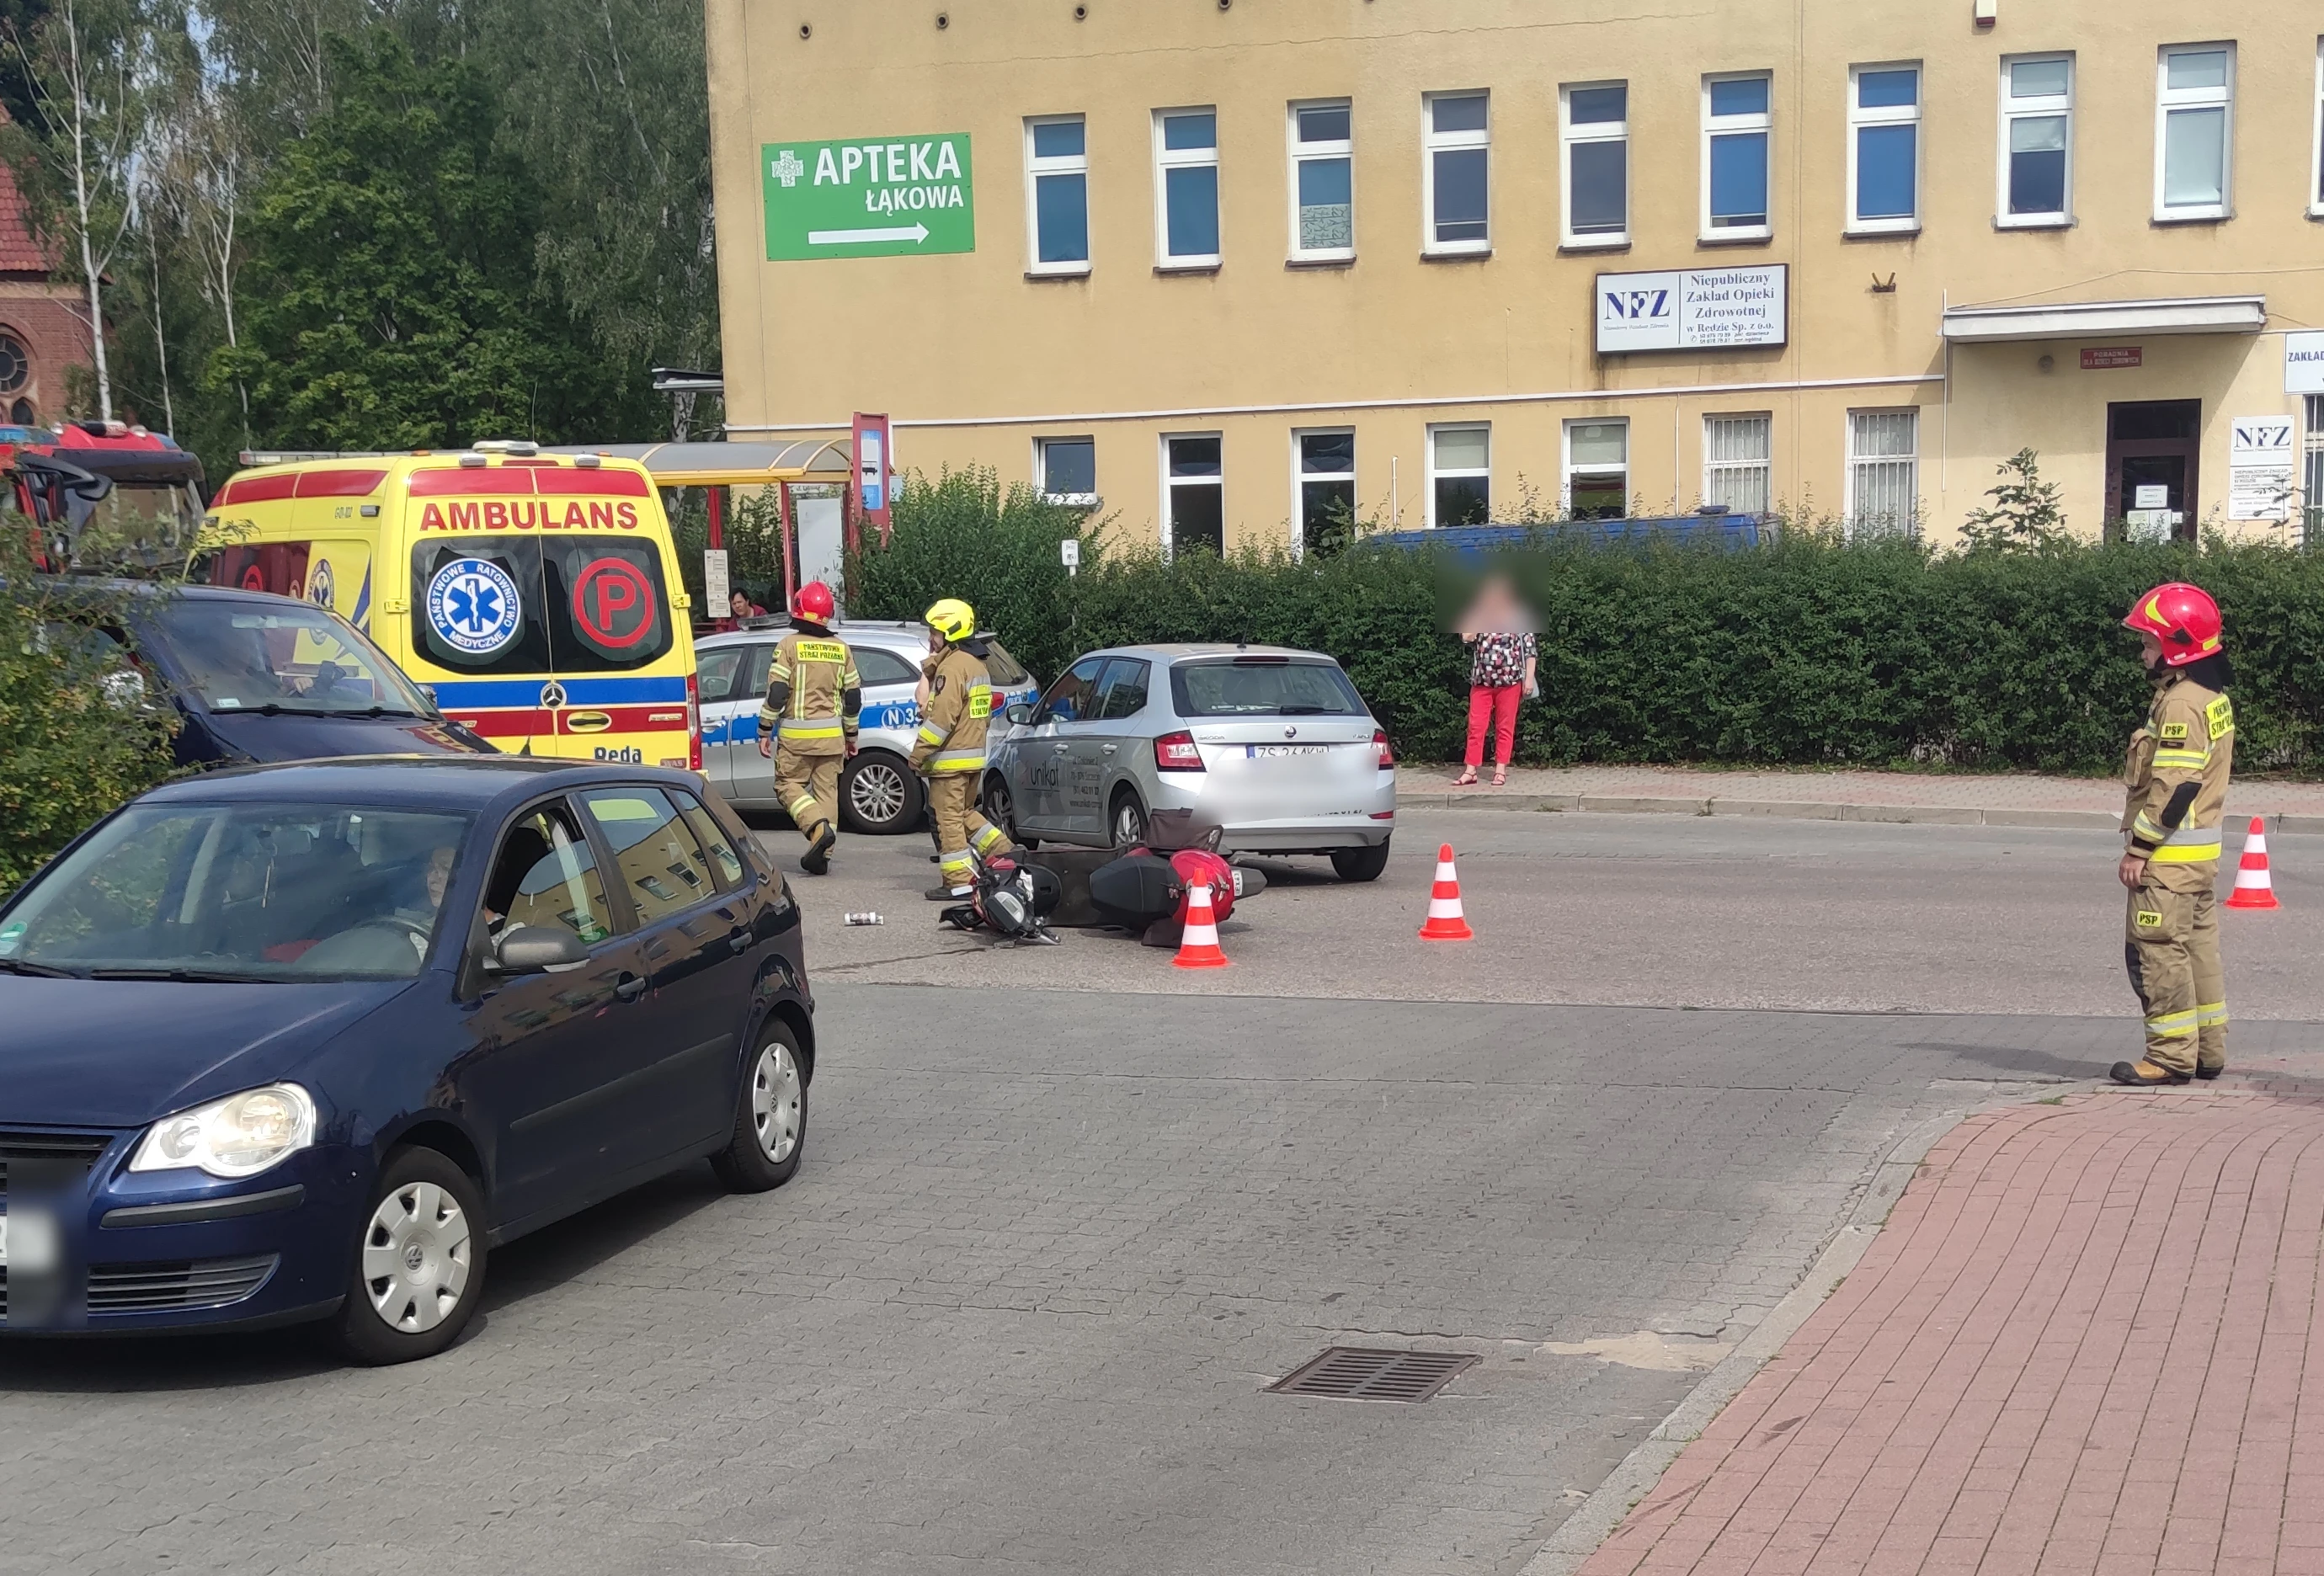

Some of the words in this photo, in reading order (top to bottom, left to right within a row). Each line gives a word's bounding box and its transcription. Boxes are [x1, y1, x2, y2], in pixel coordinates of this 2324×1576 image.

[813, 141, 962, 186] APTEKA
[865, 184, 964, 216] ŁĄKOWA
[1691, 273, 1770, 288] Niepubliczny
[1734, 287, 1774, 302] Opieki
[1603, 289, 1671, 320] NFZ
[1695, 304, 1766, 318] Zdrowotnej
[1698, 322, 1730, 333] Redzie
[1731, 322, 1747, 333] Sp.
[2234, 427, 2290, 447] NFZ
[420, 502, 638, 531] AMBULANS
[431, 563, 466, 629] PAŃSTWOWE
[476, 563, 516, 628] RATOWNICTWO
[595, 575, 637, 630] P
[448, 630, 506, 649] MEDYCZNE
[887, 709, 899, 725] N
[2164, 725, 2184, 735] PSP
[594, 745, 642, 764] Reda
[1030, 760, 1059, 789] unikat
[2140, 913, 2158, 924] PSP
